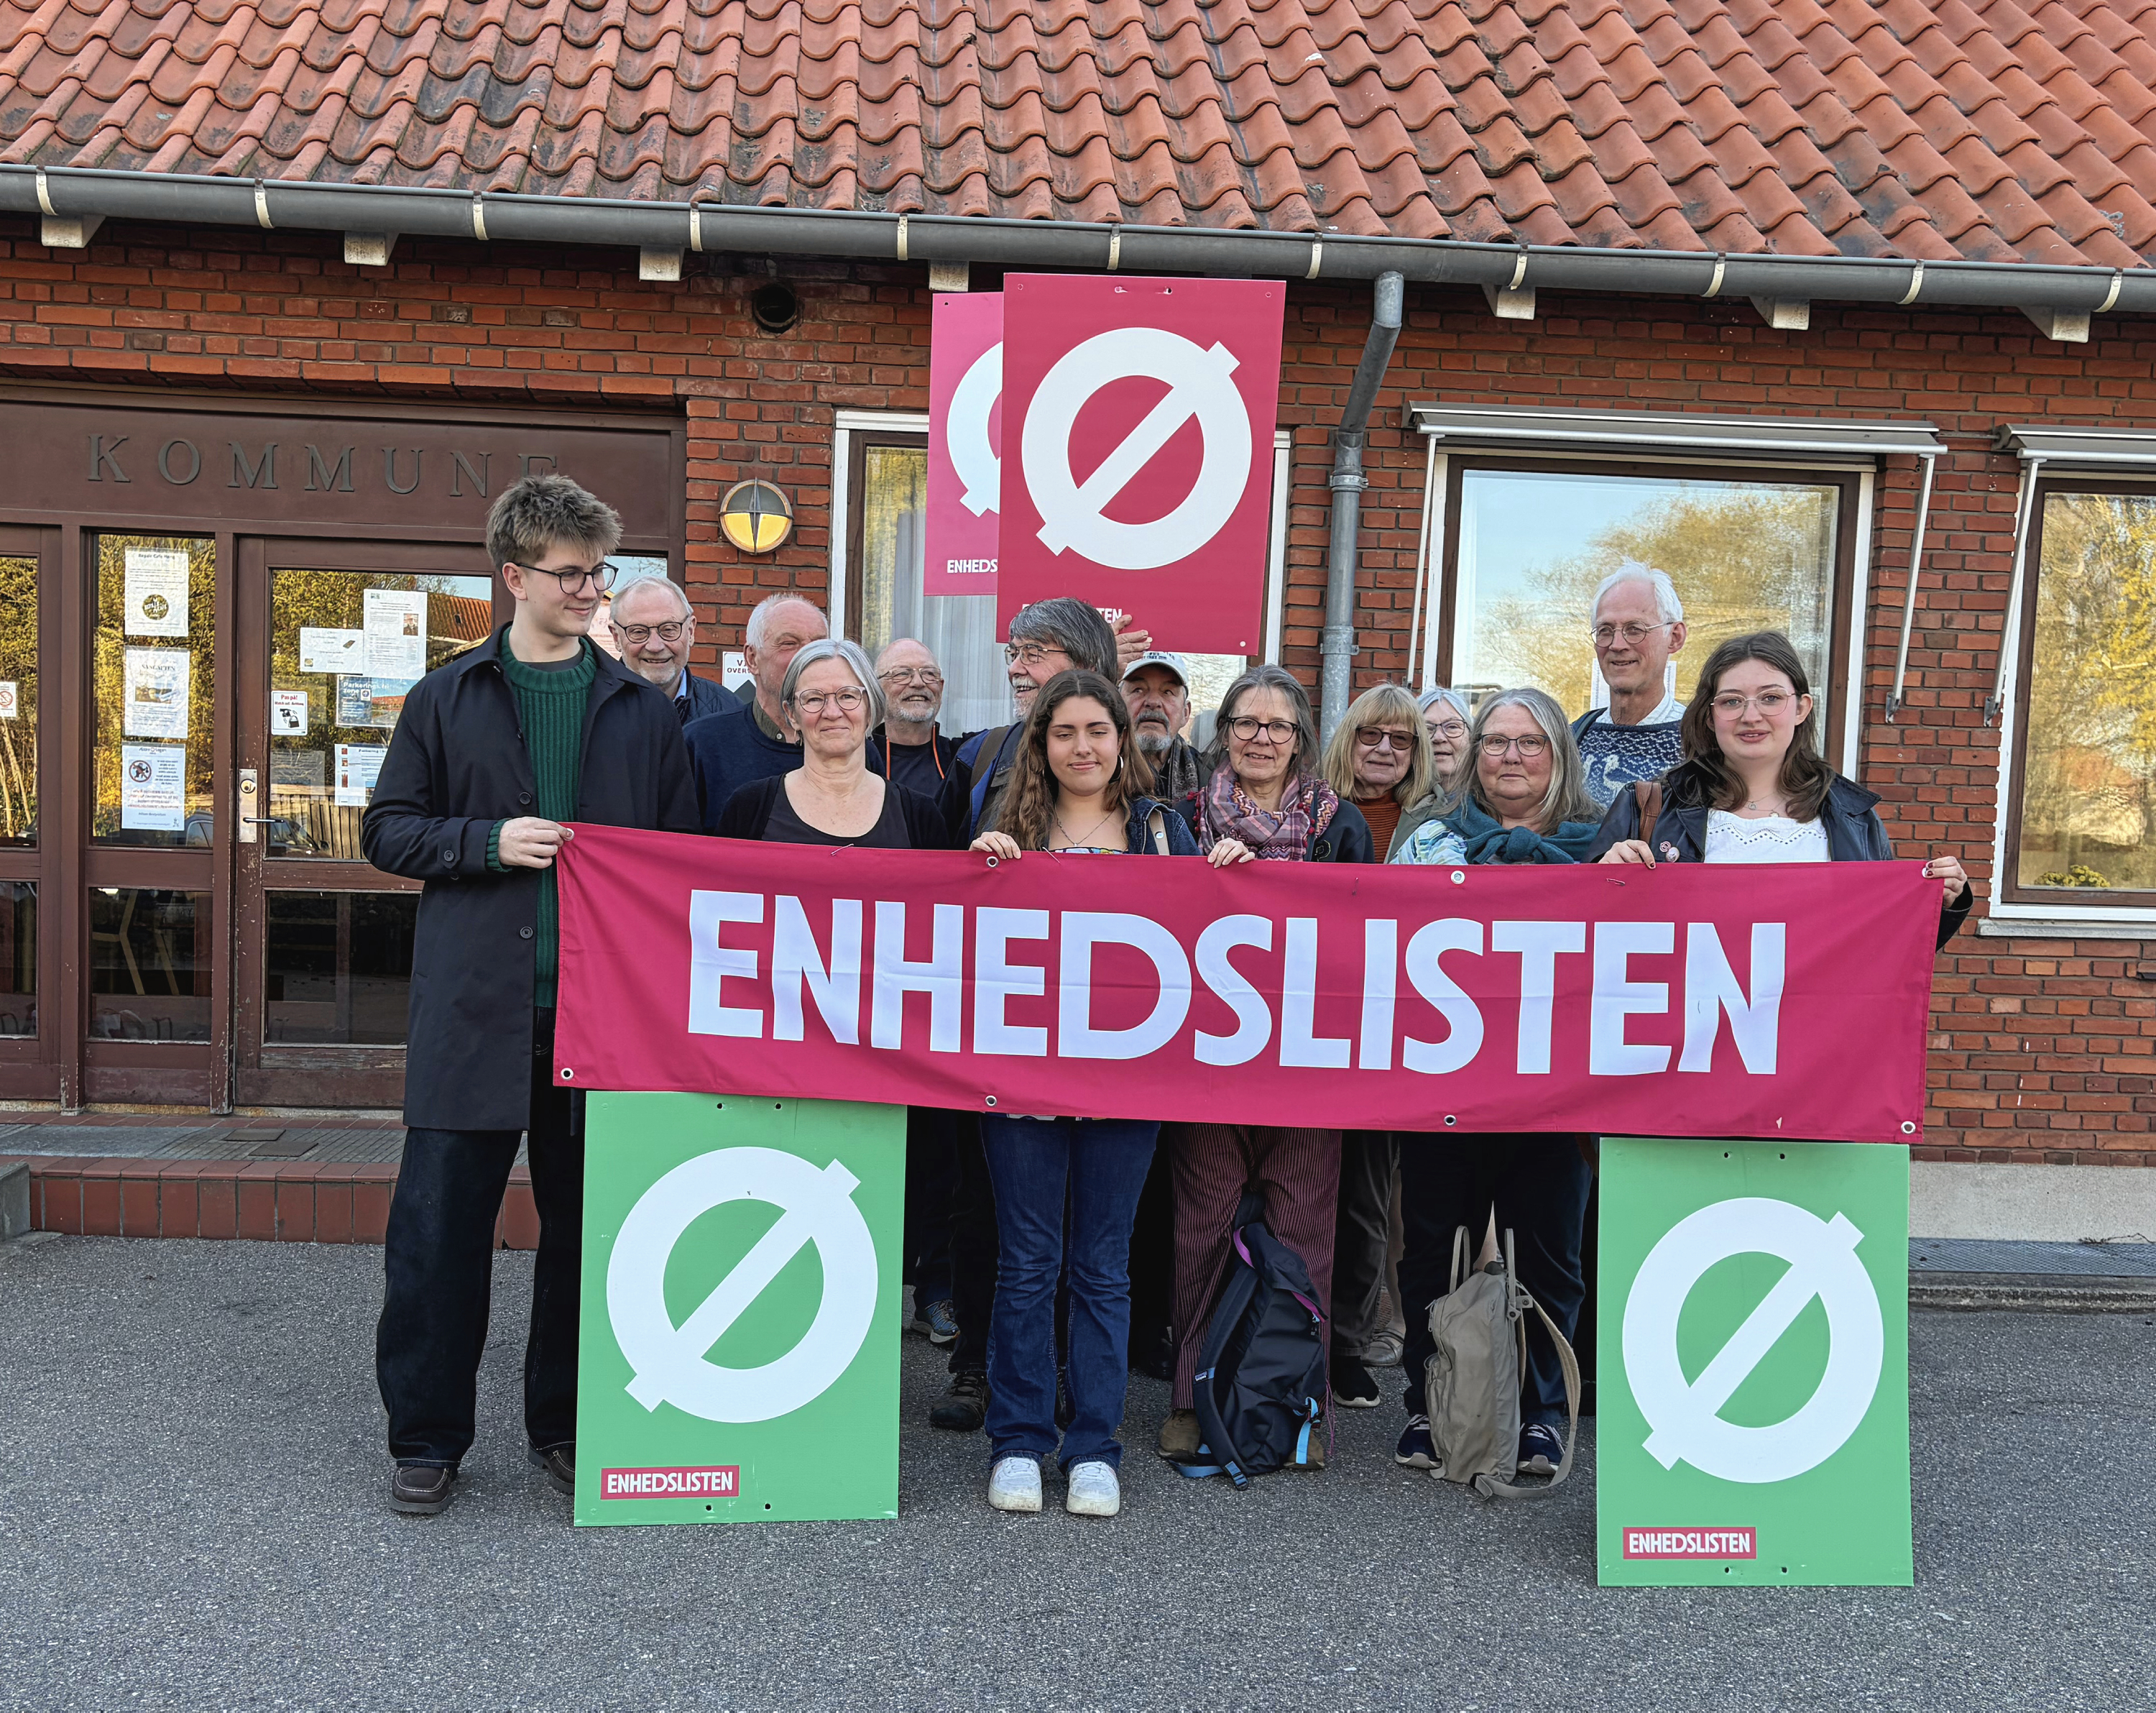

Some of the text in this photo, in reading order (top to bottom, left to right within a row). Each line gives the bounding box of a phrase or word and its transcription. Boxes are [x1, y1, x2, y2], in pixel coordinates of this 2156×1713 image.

[688, 889, 1786, 1076] ENHEDSLISTEN
[607, 1471, 733, 1494] ENHEDSLISTEN
[1629, 1533, 1751, 1553] ENHEDSLISTEN
